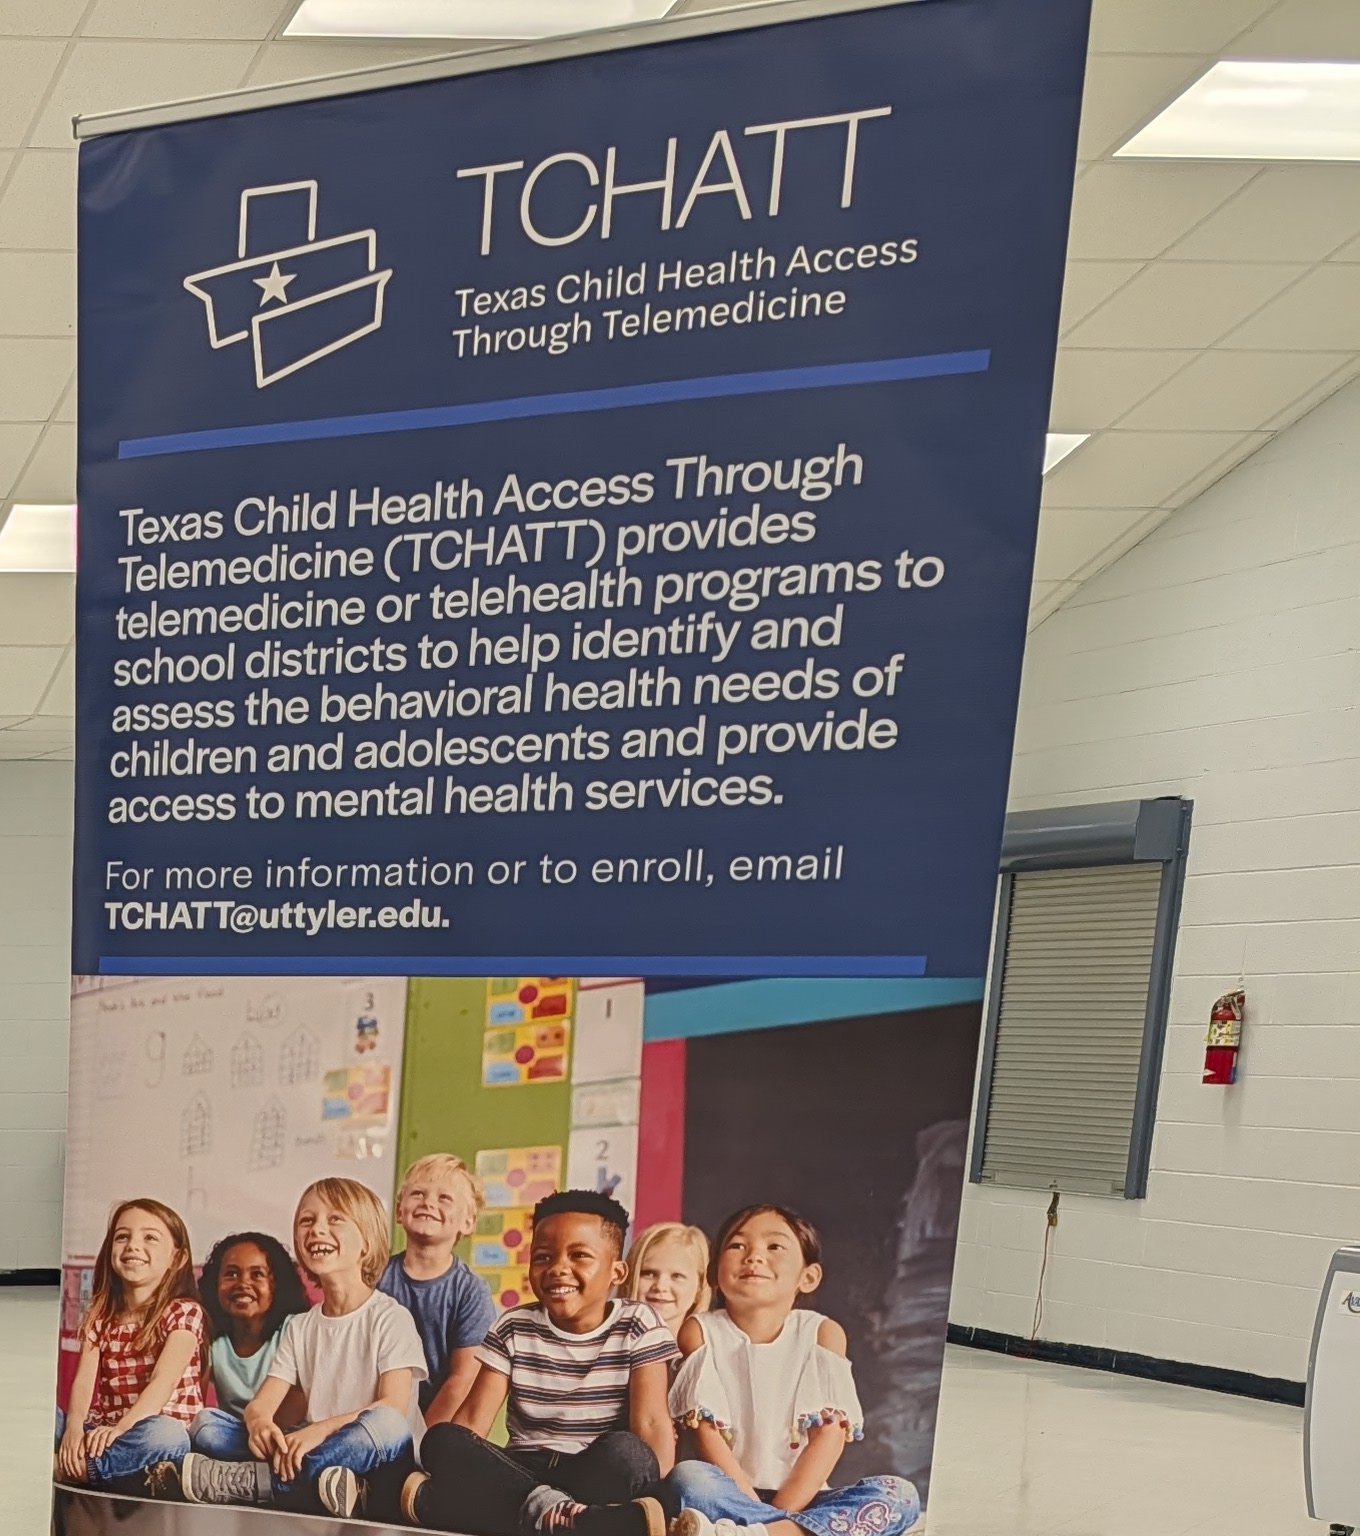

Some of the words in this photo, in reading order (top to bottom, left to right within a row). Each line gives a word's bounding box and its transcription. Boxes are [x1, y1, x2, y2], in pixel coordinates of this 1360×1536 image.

[457, 106, 892, 255] TCHATT
[455, 285, 545, 317] Texas
[557, 262, 646, 303] Child
[658, 247, 775, 291] Health
[786, 239, 917, 276] Access
[453, 312, 591, 357] Through
[603, 287, 845, 339] Telemedicine
[119, 508, 223, 546] Texas
[235, 490, 337, 536] Child
[349, 479, 483, 527] Health
[493, 473, 654, 515] Access
[666, 444, 862, 501] Through
[118, 542, 374, 593] Telemedicine
[384, 519, 605, 582] (TCHATT)
[616, 504, 816, 566] provides
[116, 591, 365, 639] telemedicine
[377, 593, 420, 623] or
[430, 567, 642, 619] telehealth
[654, 560, 882, 614] programs
[895, 550, 944, 588] to
[114, 643, 234, 686] school
[246, 637, 407, 678] districts
[418, 635, 458, 669] to
[469, 624, 560, 672] help
[572, 611, 741, 662] identify
[751, 604, 843, 649] and
[112, 700, 234, 732] assess
[245, 688, 309, 725] the
[321, 674, 533, 722] behavioral
[545, 666, 680, 711] health
[694, 658, 839, 704] needs
[853, 653, 905, 696] of
[110, 739, 256, 777] children
[268, 733, 343, 772] and
[355, 725, 609, 769] adolescents
[621, 715, 705, 758] and
[717, 709, 898, 765] provide
[108, 794, 236, 823] access
[246, 786, 284, 819] to
[296, 777, 434, 818] mental
[445, 772, 573, 813] health
[585, 768, 783, 810] services.
[107, 861, 154, 889] For
[166, 867, 252, 888] more
[267, 857, 473, 887] information
[488, 861, 526, 884] or
[540, 855, 577, 883] to
[592, 849, 713, 887] enroll,
[730, 845, 843, 880] email
[105, 899, 449, 935] TCHATT@uttyler.edu.
